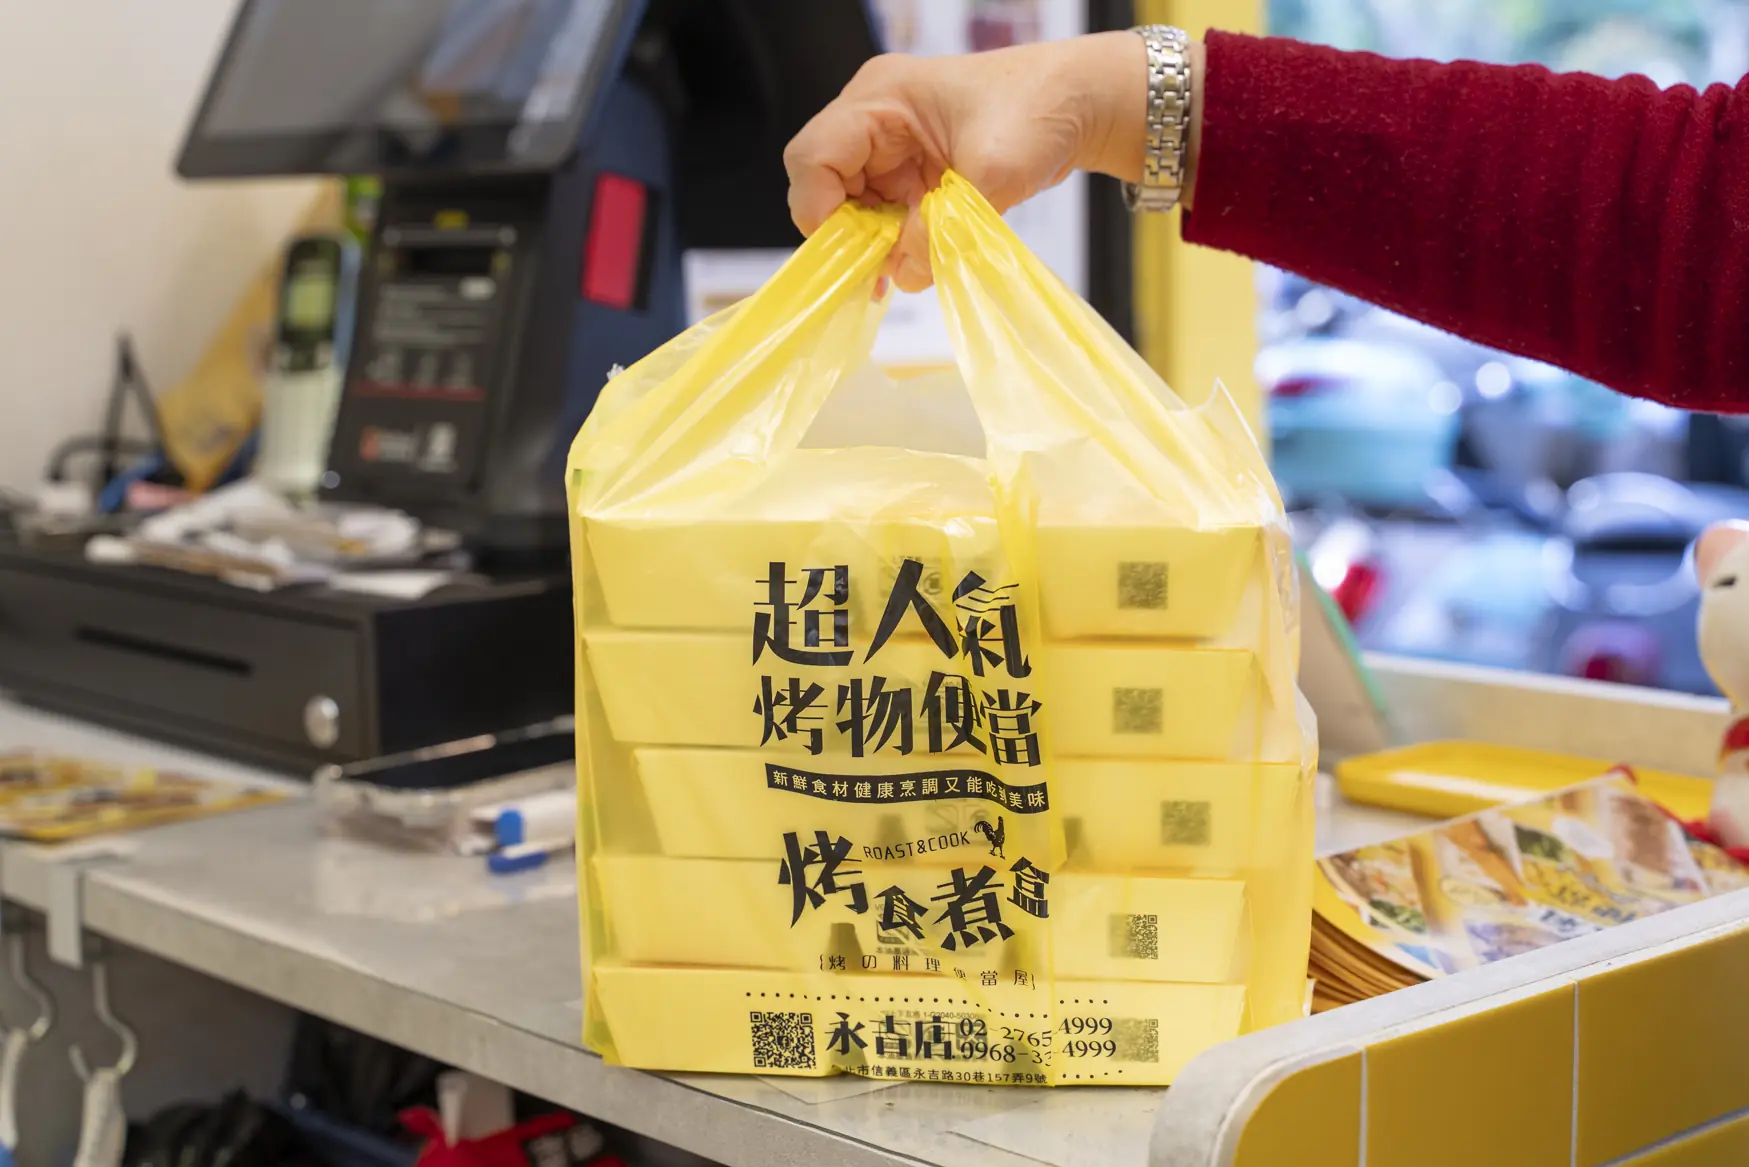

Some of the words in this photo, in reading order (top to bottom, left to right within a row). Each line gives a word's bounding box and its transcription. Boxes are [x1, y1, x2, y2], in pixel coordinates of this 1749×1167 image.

[752, 559, 1032, 679] 超人氣
[752, 670, 1043, 768] 烤物便當
[773, 770, 1046, 810] 新鮮食材健康烹調又能吃到美味
[863, 831, 970, 860] ROAST&COOK
[825, 1011, 955, 1060] 永吉店
[831, 1064, 1048, 1084] 北市信義區永吉路30巷157弄9號
